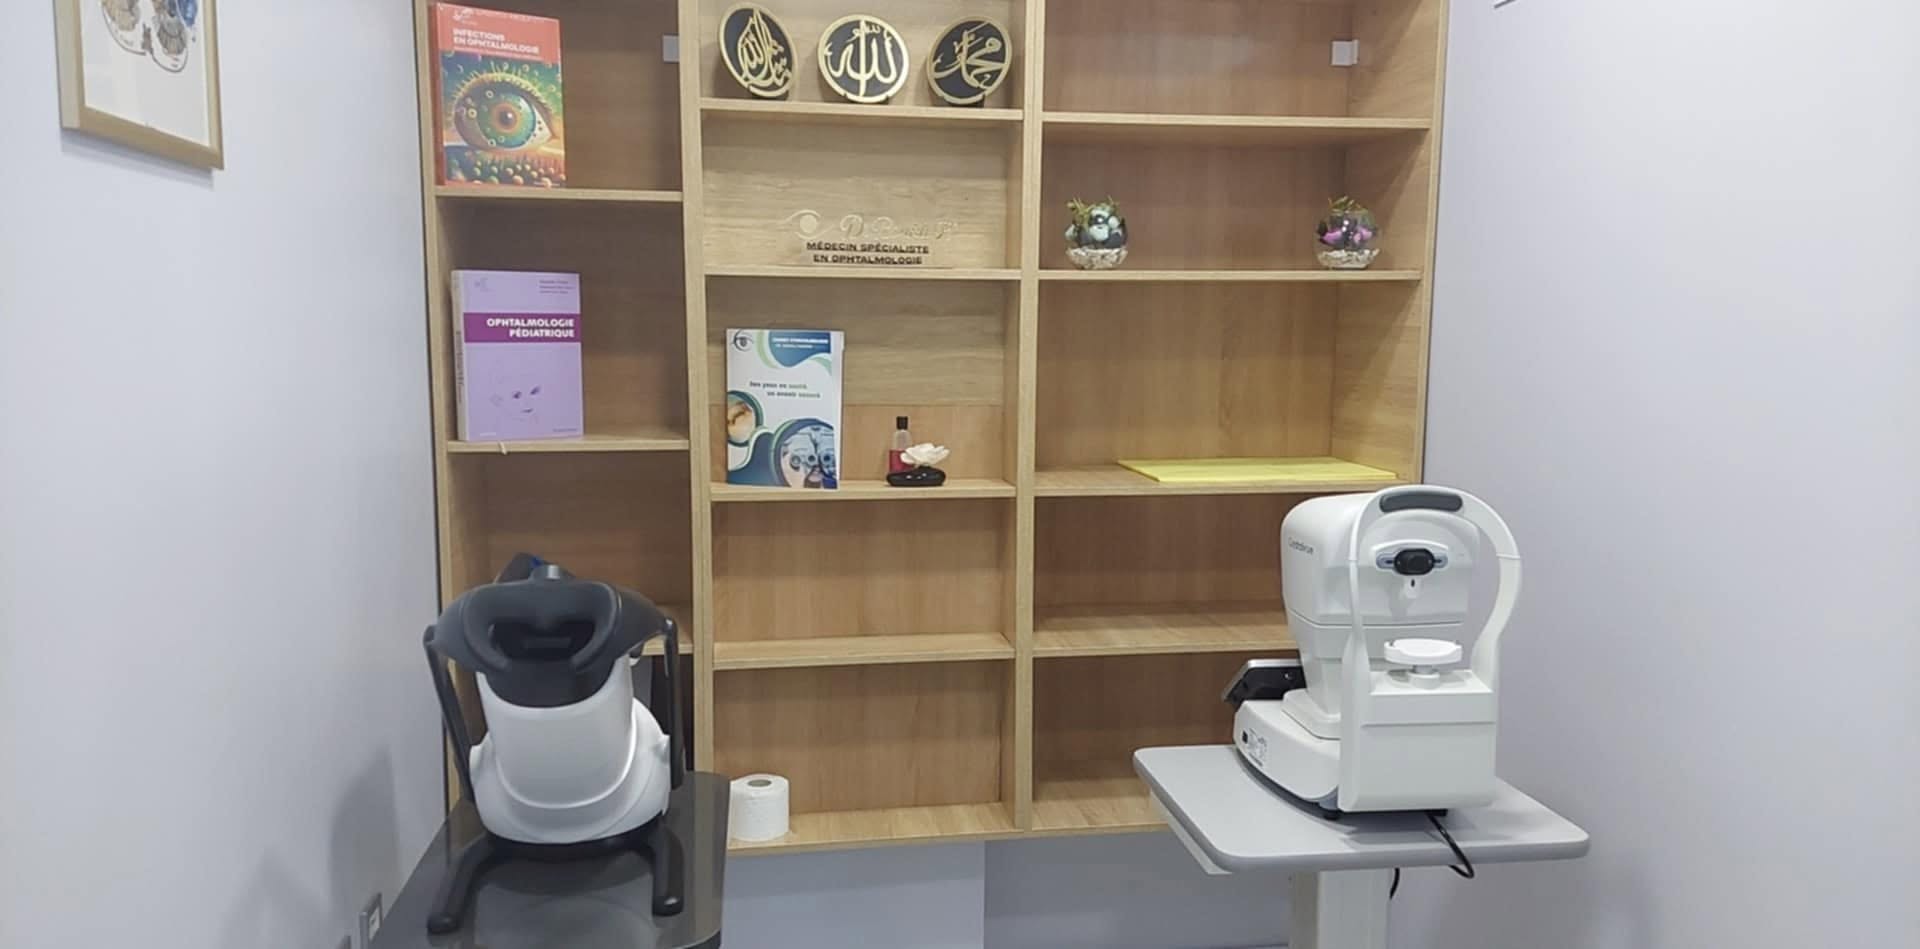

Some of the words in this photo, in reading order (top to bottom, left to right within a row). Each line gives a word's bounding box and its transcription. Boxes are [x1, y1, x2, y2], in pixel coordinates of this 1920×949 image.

[453, 28, 505, 41] INFECTIONS
[453, 36, 466, 45] EN
[467, 38, 539, 54] OPHTALMOLOGIE
[806, 241, 857, 251] MÉDECIN
[860, 243, 929, 254] SPÉCIALISTE
[813, 254, 828, 263] EN
[831, 254, 923, 265] OPHTALMOLOGIE
[486, 318, 575, 327] OPHTALMOLOGIE
[509, 327, 575, 338] PÉDIATRIQUE
